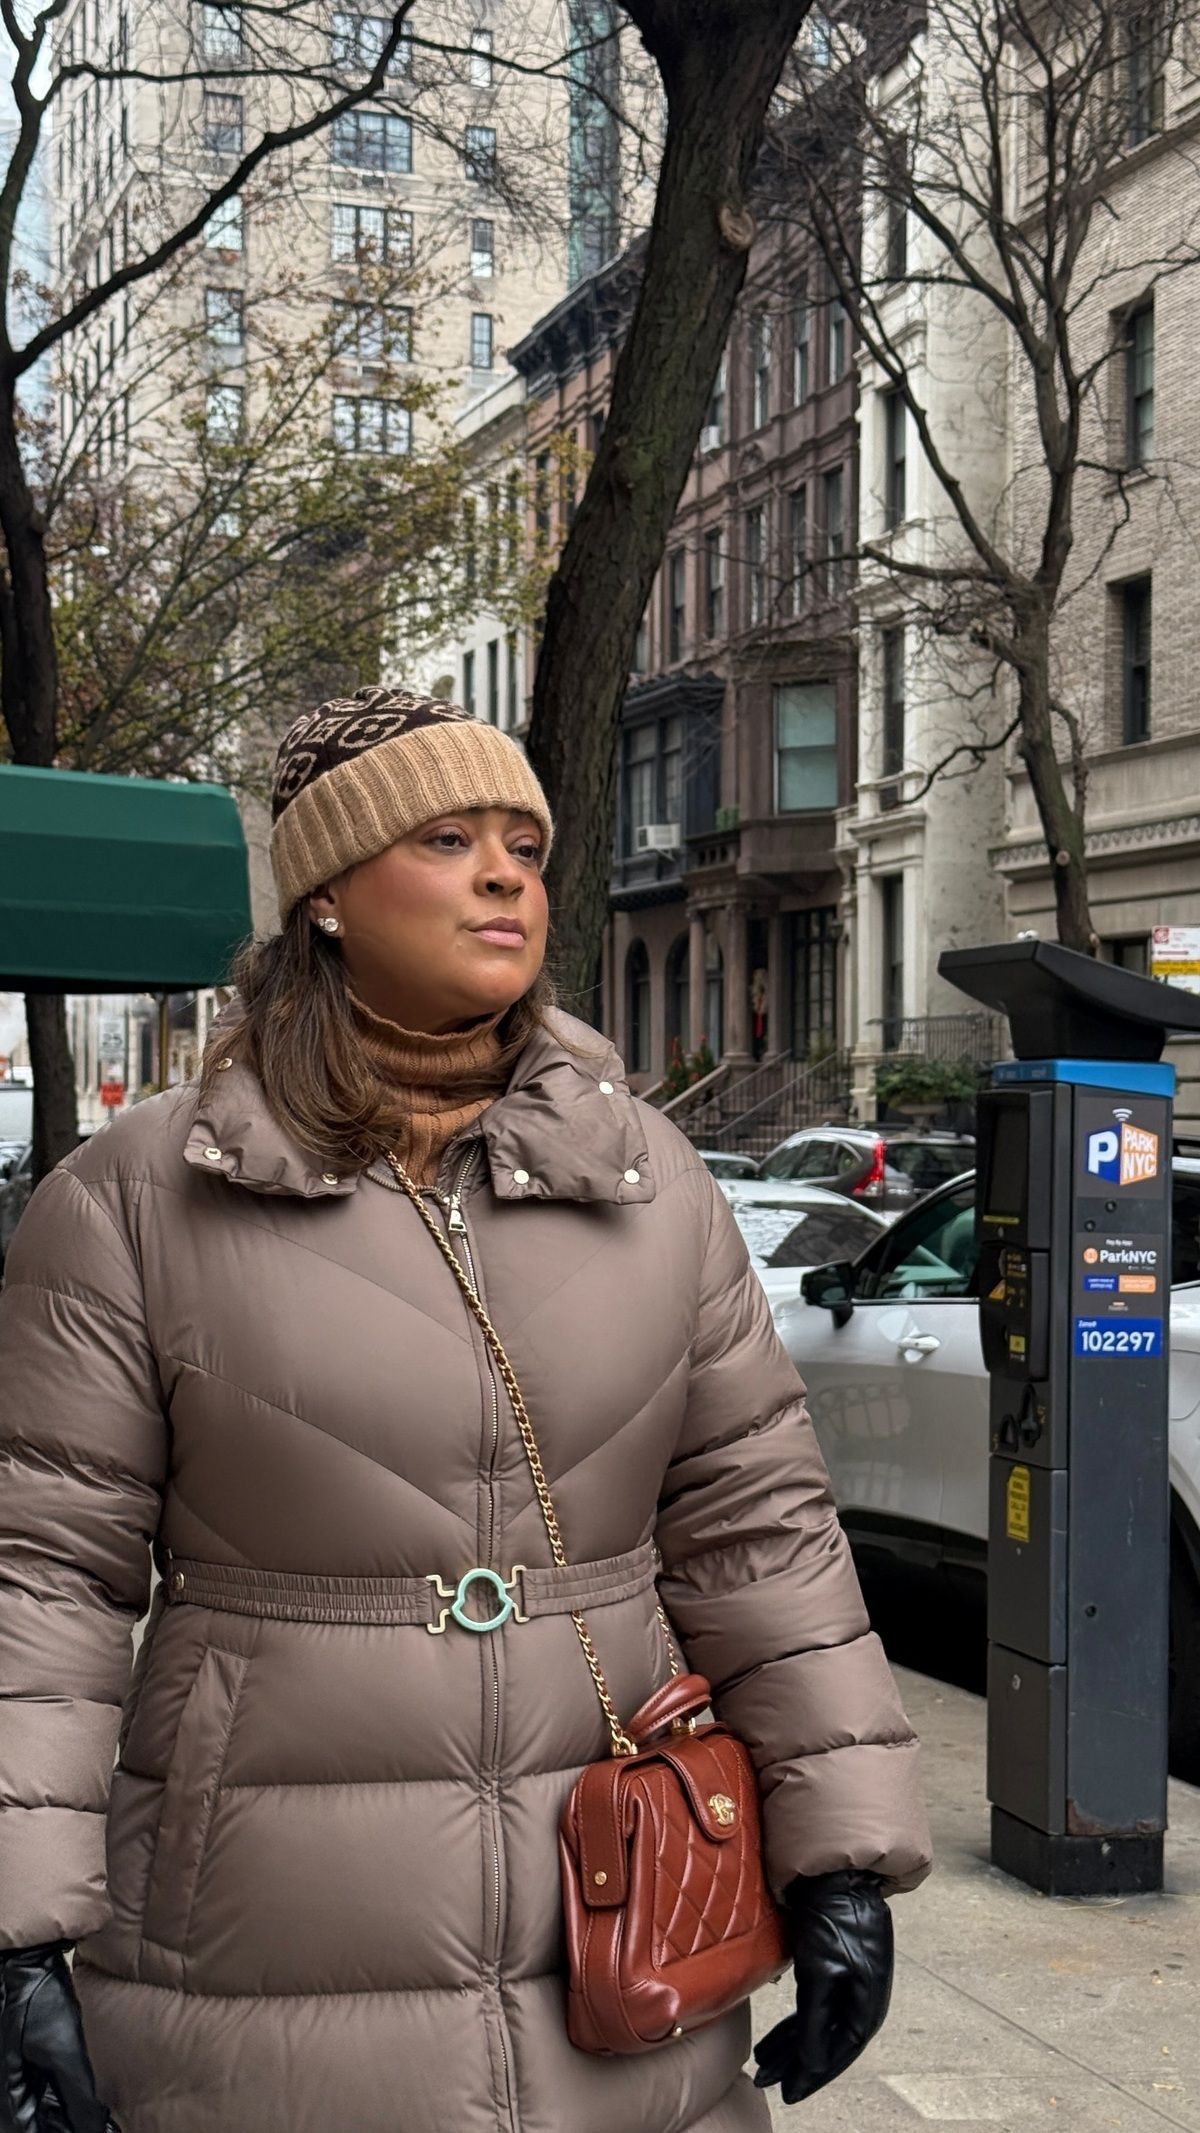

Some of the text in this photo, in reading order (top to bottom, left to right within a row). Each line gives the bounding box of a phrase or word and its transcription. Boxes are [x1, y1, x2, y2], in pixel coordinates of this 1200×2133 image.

[1124, 1127, 1155, 1152] PARK
[1088, 1131, 1119, 1174] P
[1122, 1151, 1156, 1179] NYC
[1100, 1249, 1157, 1264] ParkNYC
[1082, 1331, 1156, 1353] 102297
